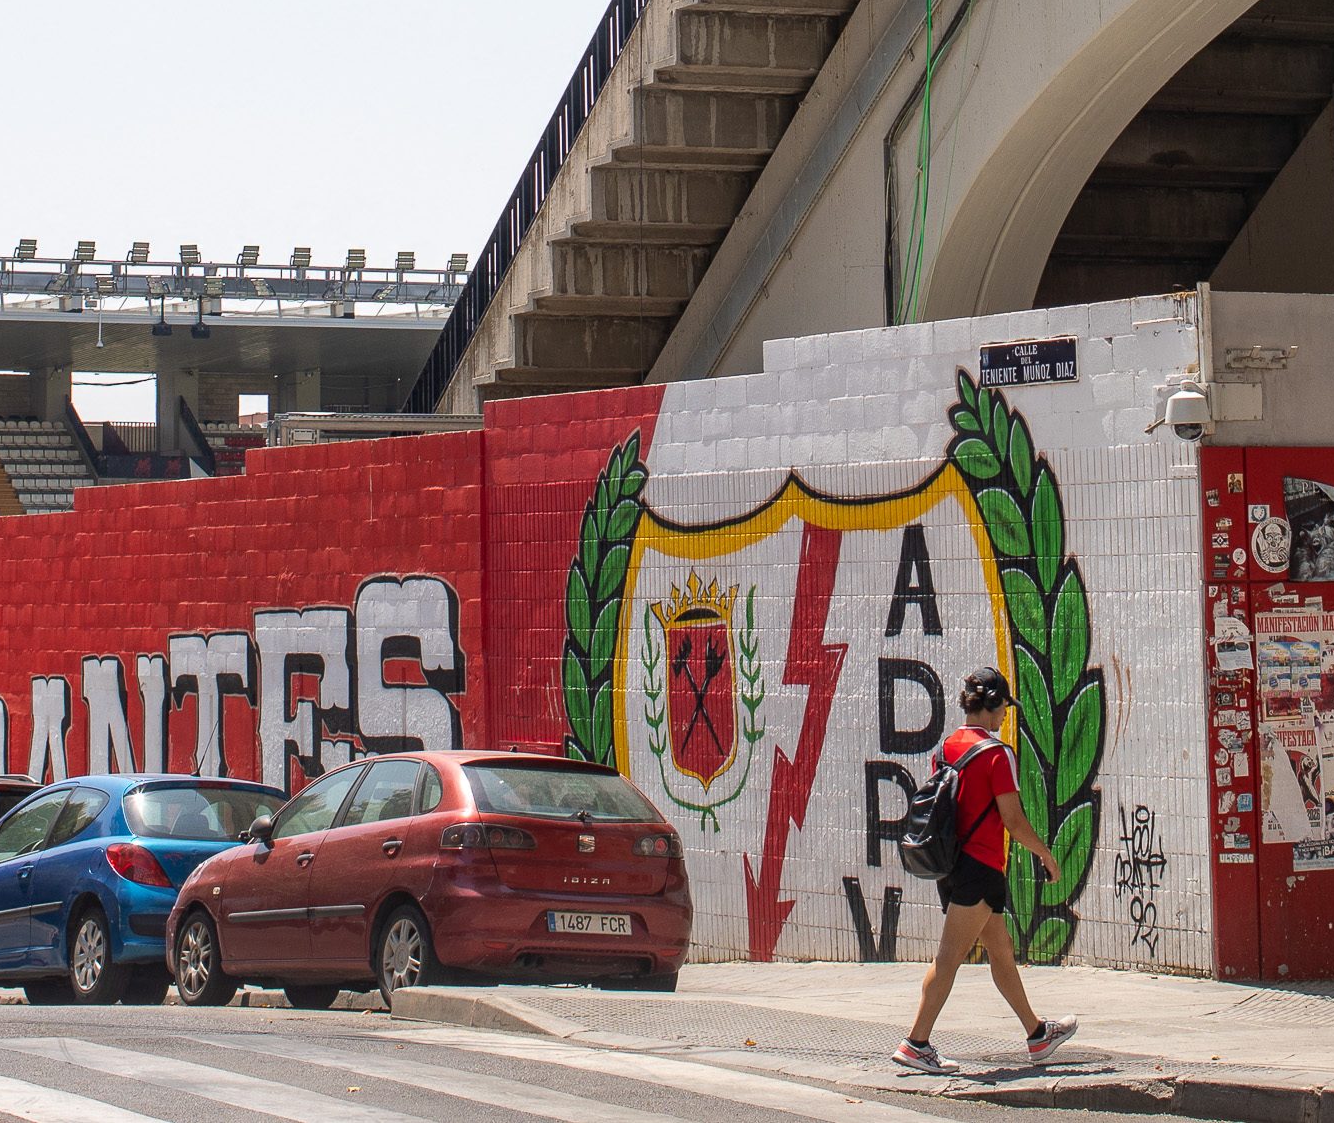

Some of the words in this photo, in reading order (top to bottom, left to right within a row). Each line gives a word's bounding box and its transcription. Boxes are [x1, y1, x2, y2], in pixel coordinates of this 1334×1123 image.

[1014, 344, 1038, 356] CALLE
[982, 368, 1017, 384] TENIENTE
[1023, 362, 1051, 382] MUÑOZ
[1056, 361, 1075, 377] DIAZ
[1257, 614, 1319, 633] MANIFESTACIÓN
[564, 876, 610, 885] IBIZA
[560, 914, 592, 931] 1487
[600, 917, 626, 933] FCR
